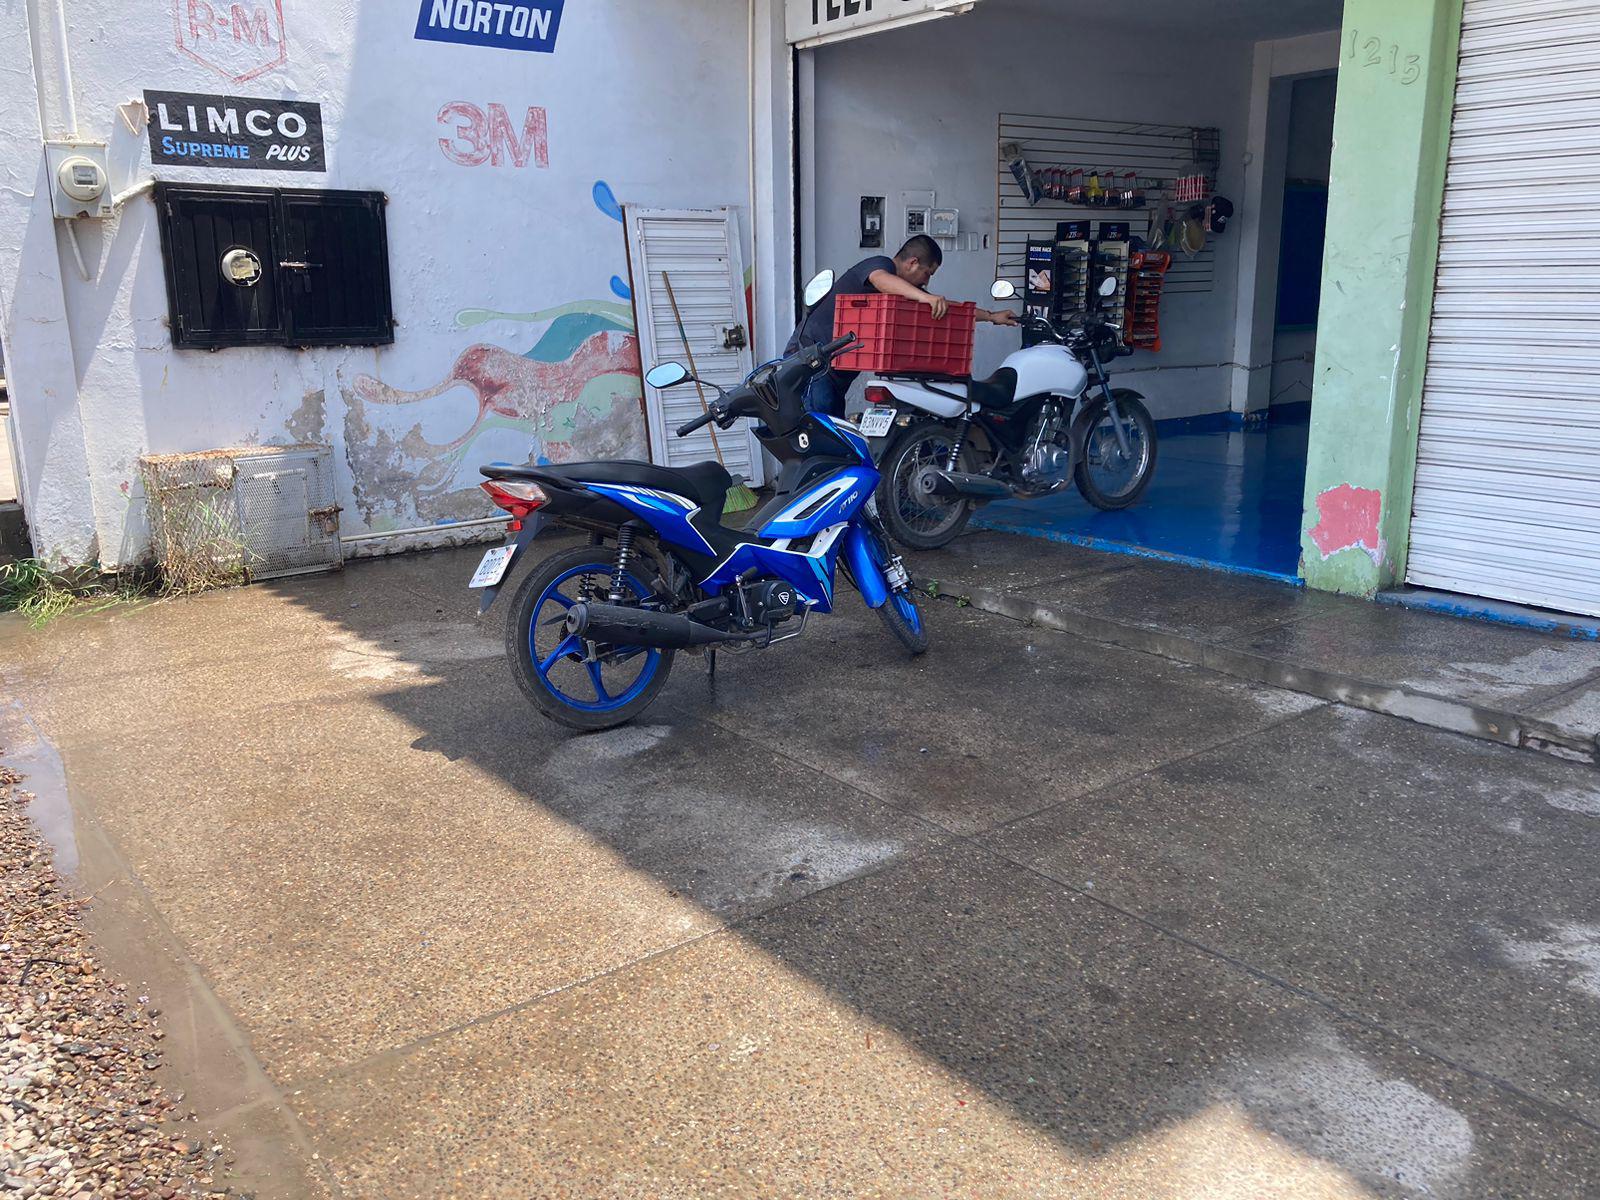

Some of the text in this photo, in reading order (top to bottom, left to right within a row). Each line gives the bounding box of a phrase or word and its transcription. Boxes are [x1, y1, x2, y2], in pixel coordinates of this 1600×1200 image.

[428, 0, 552, 40] NORTON
[157, 102, 307, 139] LIMCO
[437, 100, 549, 169] 3M
[265, 144, 311, 162] PLUS
